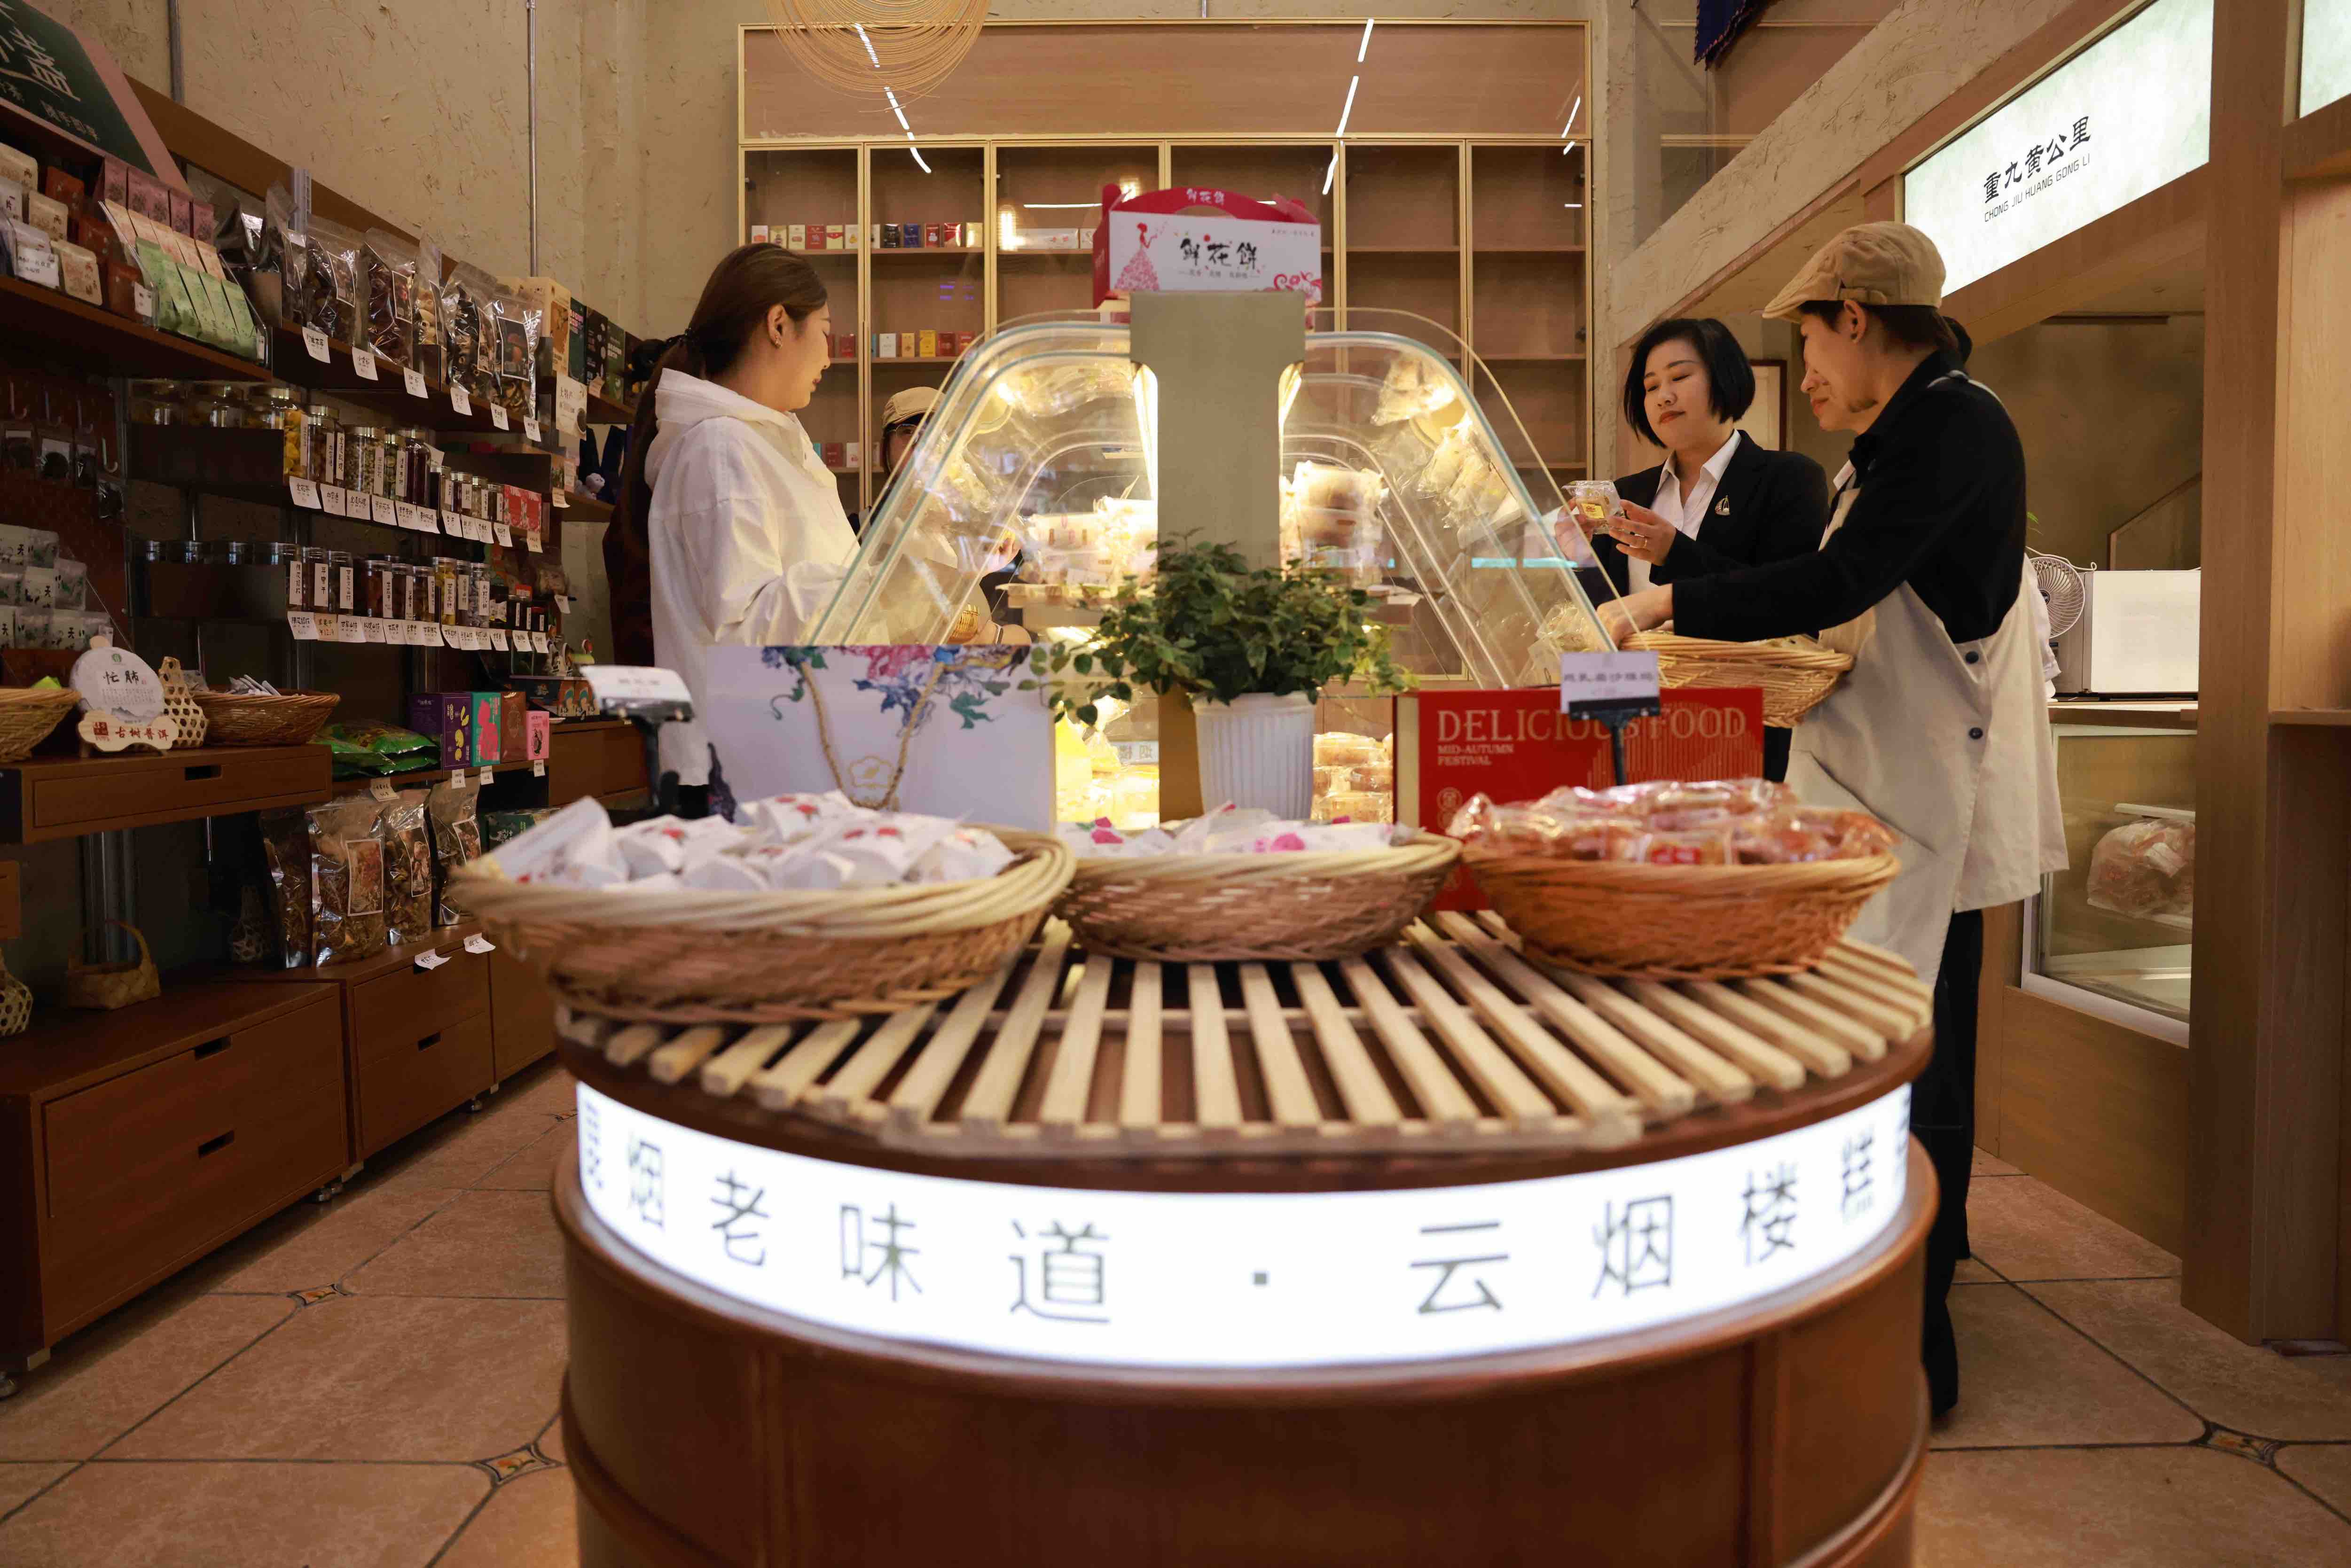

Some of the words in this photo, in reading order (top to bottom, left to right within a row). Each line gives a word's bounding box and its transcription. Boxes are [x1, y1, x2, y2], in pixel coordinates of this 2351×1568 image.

[1983, 116, 2091, 203] 重九黄公里
[1984, 200, 2009, 222] CHONG
[2012, 193, 2022, 208] JIU
[2026, 176, 2053, 198] HUANG
[2056, 160, 2079, 181] GONG
[2083, 154, 2090, 166] LI
[103, 670, 139, 685] 忙肺
[1650, 707, 1746, 739] FOOD
[115, 726, 169, 741] 古树普洱
[1437, 744, 1514, 754] MID-AUTUMN
[1437, 755, 1492, 766] FESTIVAL
